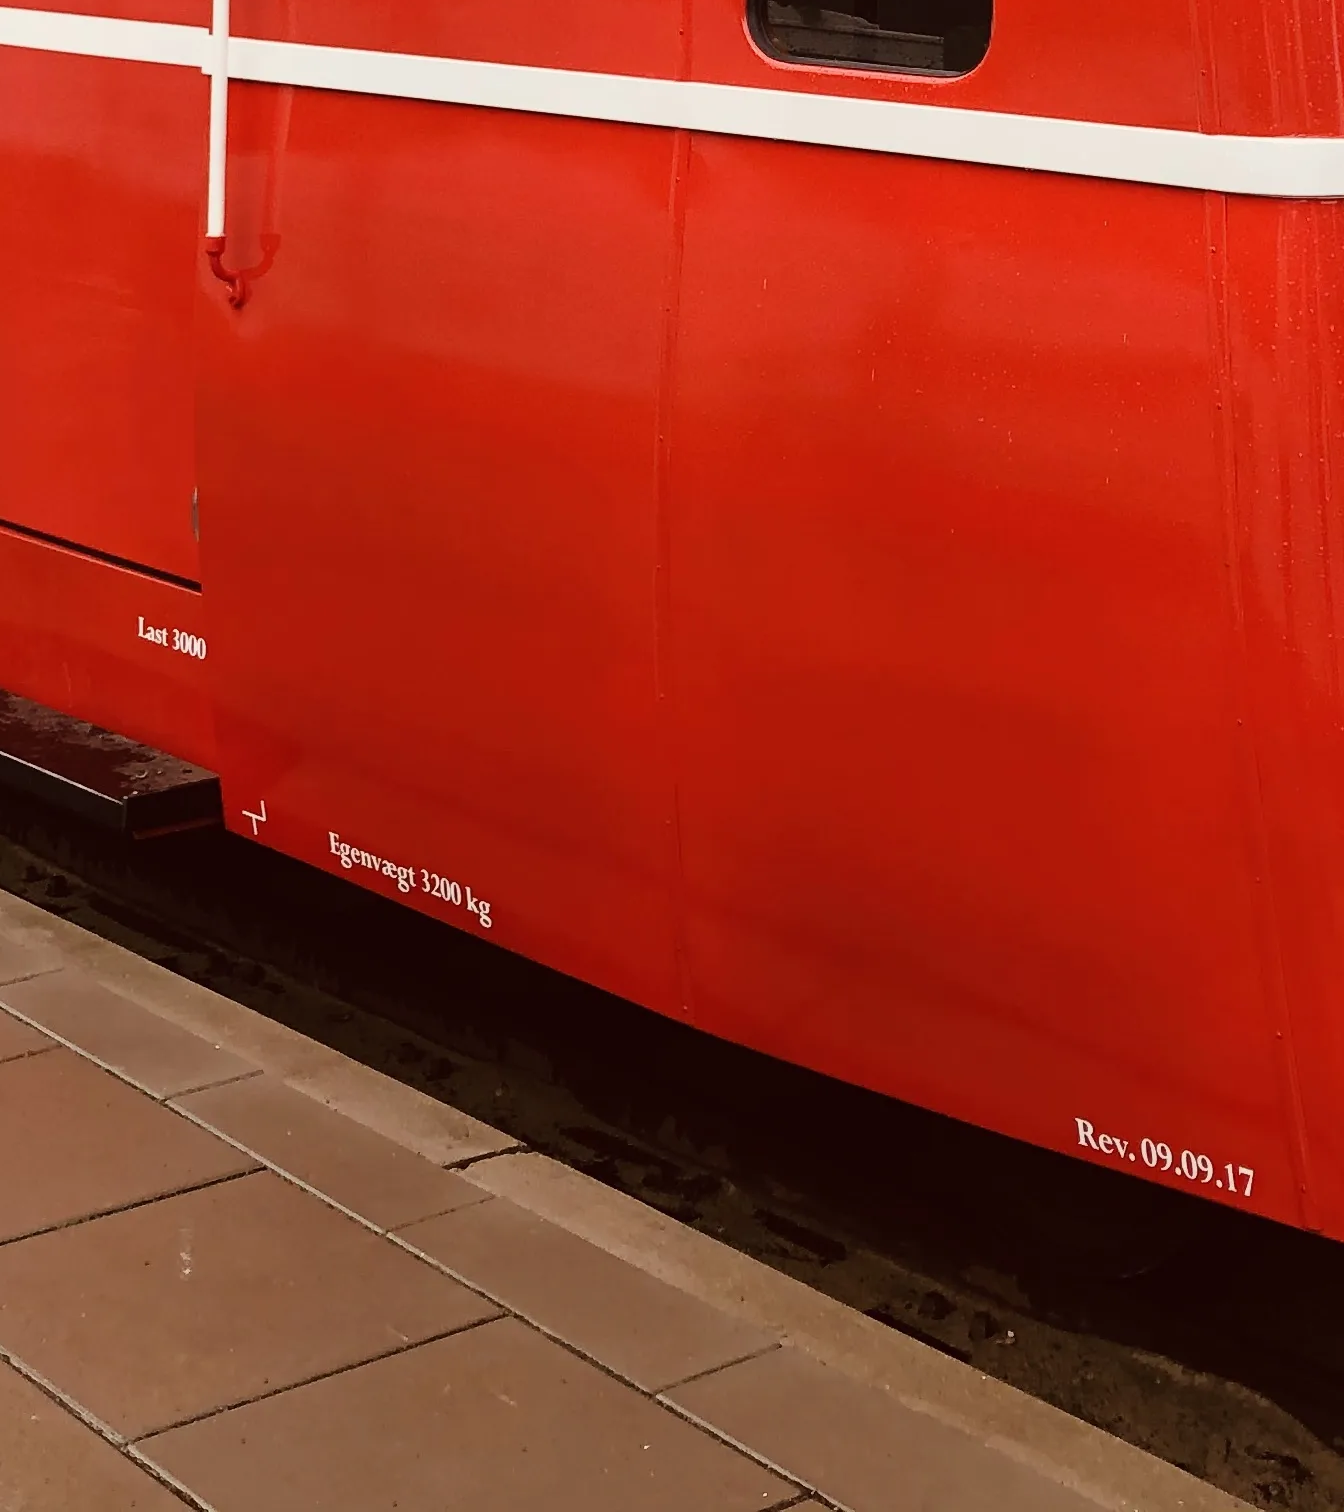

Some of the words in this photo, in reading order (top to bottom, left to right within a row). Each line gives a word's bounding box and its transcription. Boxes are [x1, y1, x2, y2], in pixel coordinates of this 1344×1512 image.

[138, 617, 168, 646] Last
[172, 629, 206, 660] 3000
[328, 832, 416, 892] Egenvægt
[421, 869, 462, 906] 3200
[465, 887, 492, 928] kg
[1074, 1117, 1136, 1162] Rev.
[1140, 1138, 1254, 1197] 09.09.17
